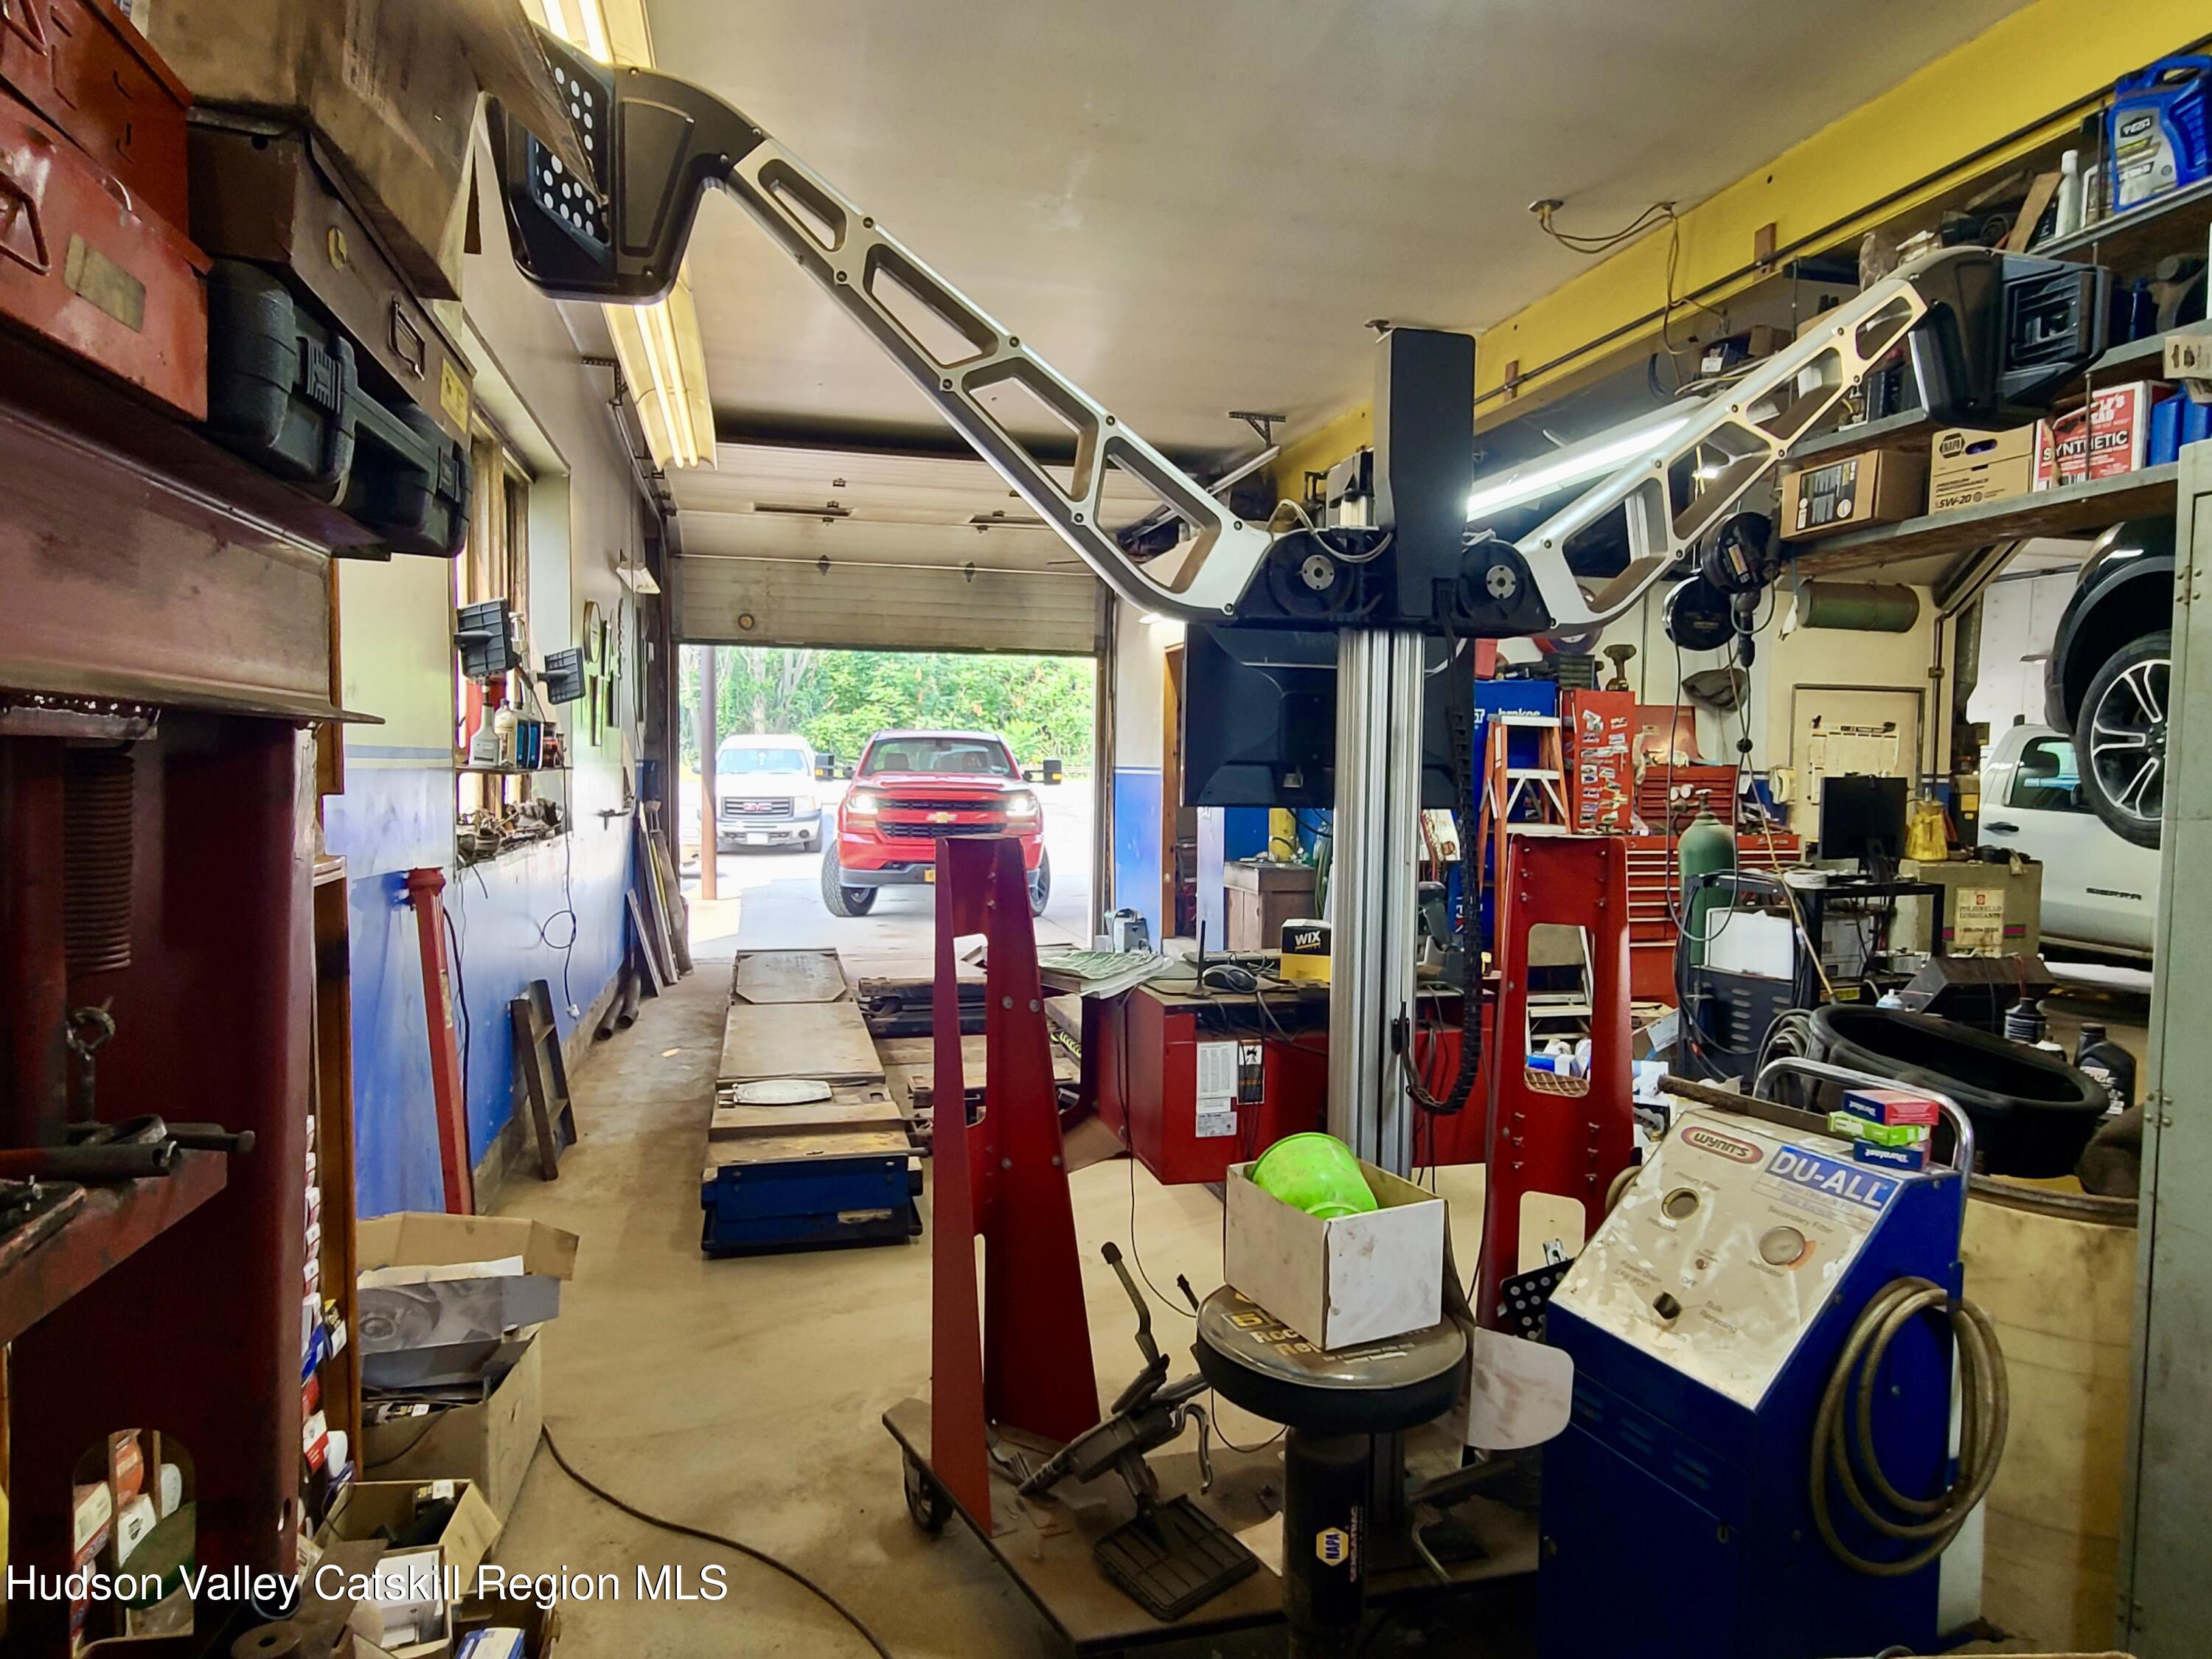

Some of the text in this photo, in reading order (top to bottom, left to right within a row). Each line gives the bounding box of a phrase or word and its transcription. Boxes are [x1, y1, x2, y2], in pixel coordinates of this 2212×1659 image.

[1938, 493, 1972, 508] 5W-20
[2086, 887, 2142, 900] SIERRA
[1294, 930, 1322, 946] WIX
[1865, 1148, 1910, 1164] Duralast
[1770, 1150, 1882, 1207] DU-ALL
[1325, 1533, 1341, 1559] NAPA
